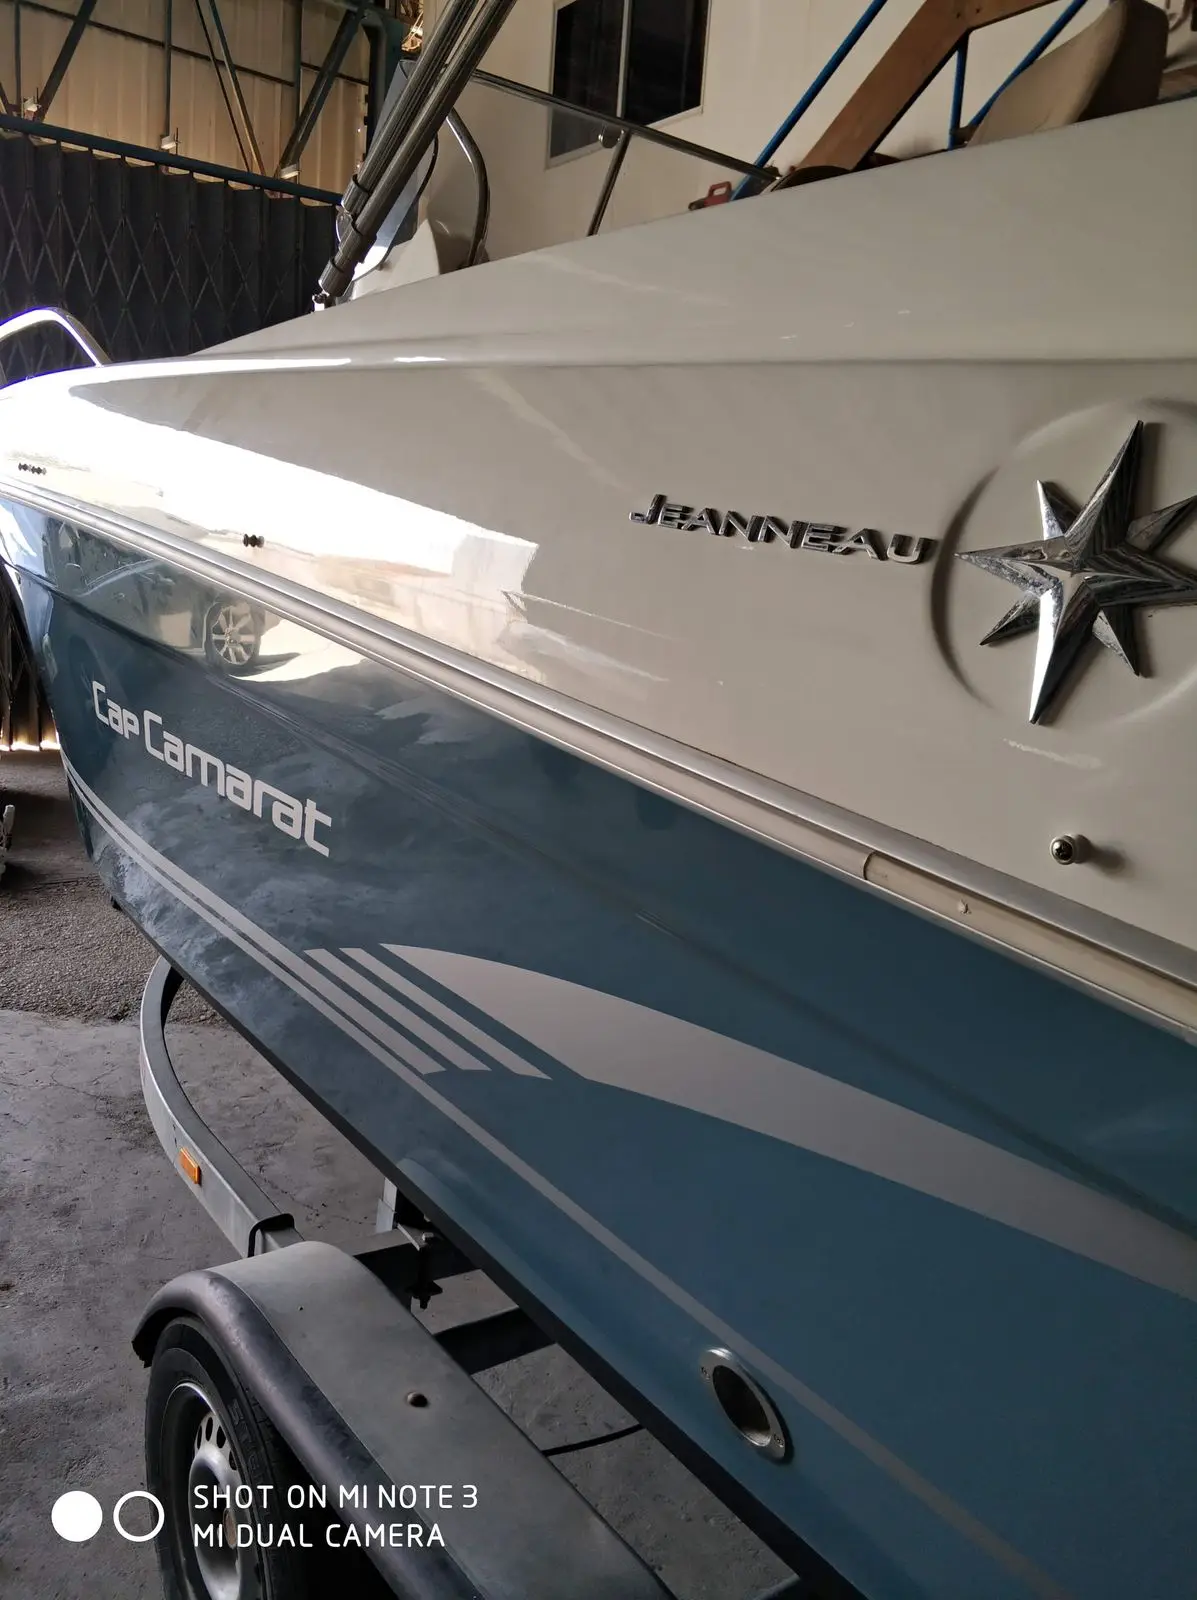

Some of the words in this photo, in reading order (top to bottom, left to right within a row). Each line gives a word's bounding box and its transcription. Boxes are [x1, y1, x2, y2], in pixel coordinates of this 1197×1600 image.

[628, 493, 937, 565] JEANNEAU
[92, 680, 140, 740] Cap
[143, 709, 332, 858] Camarat
